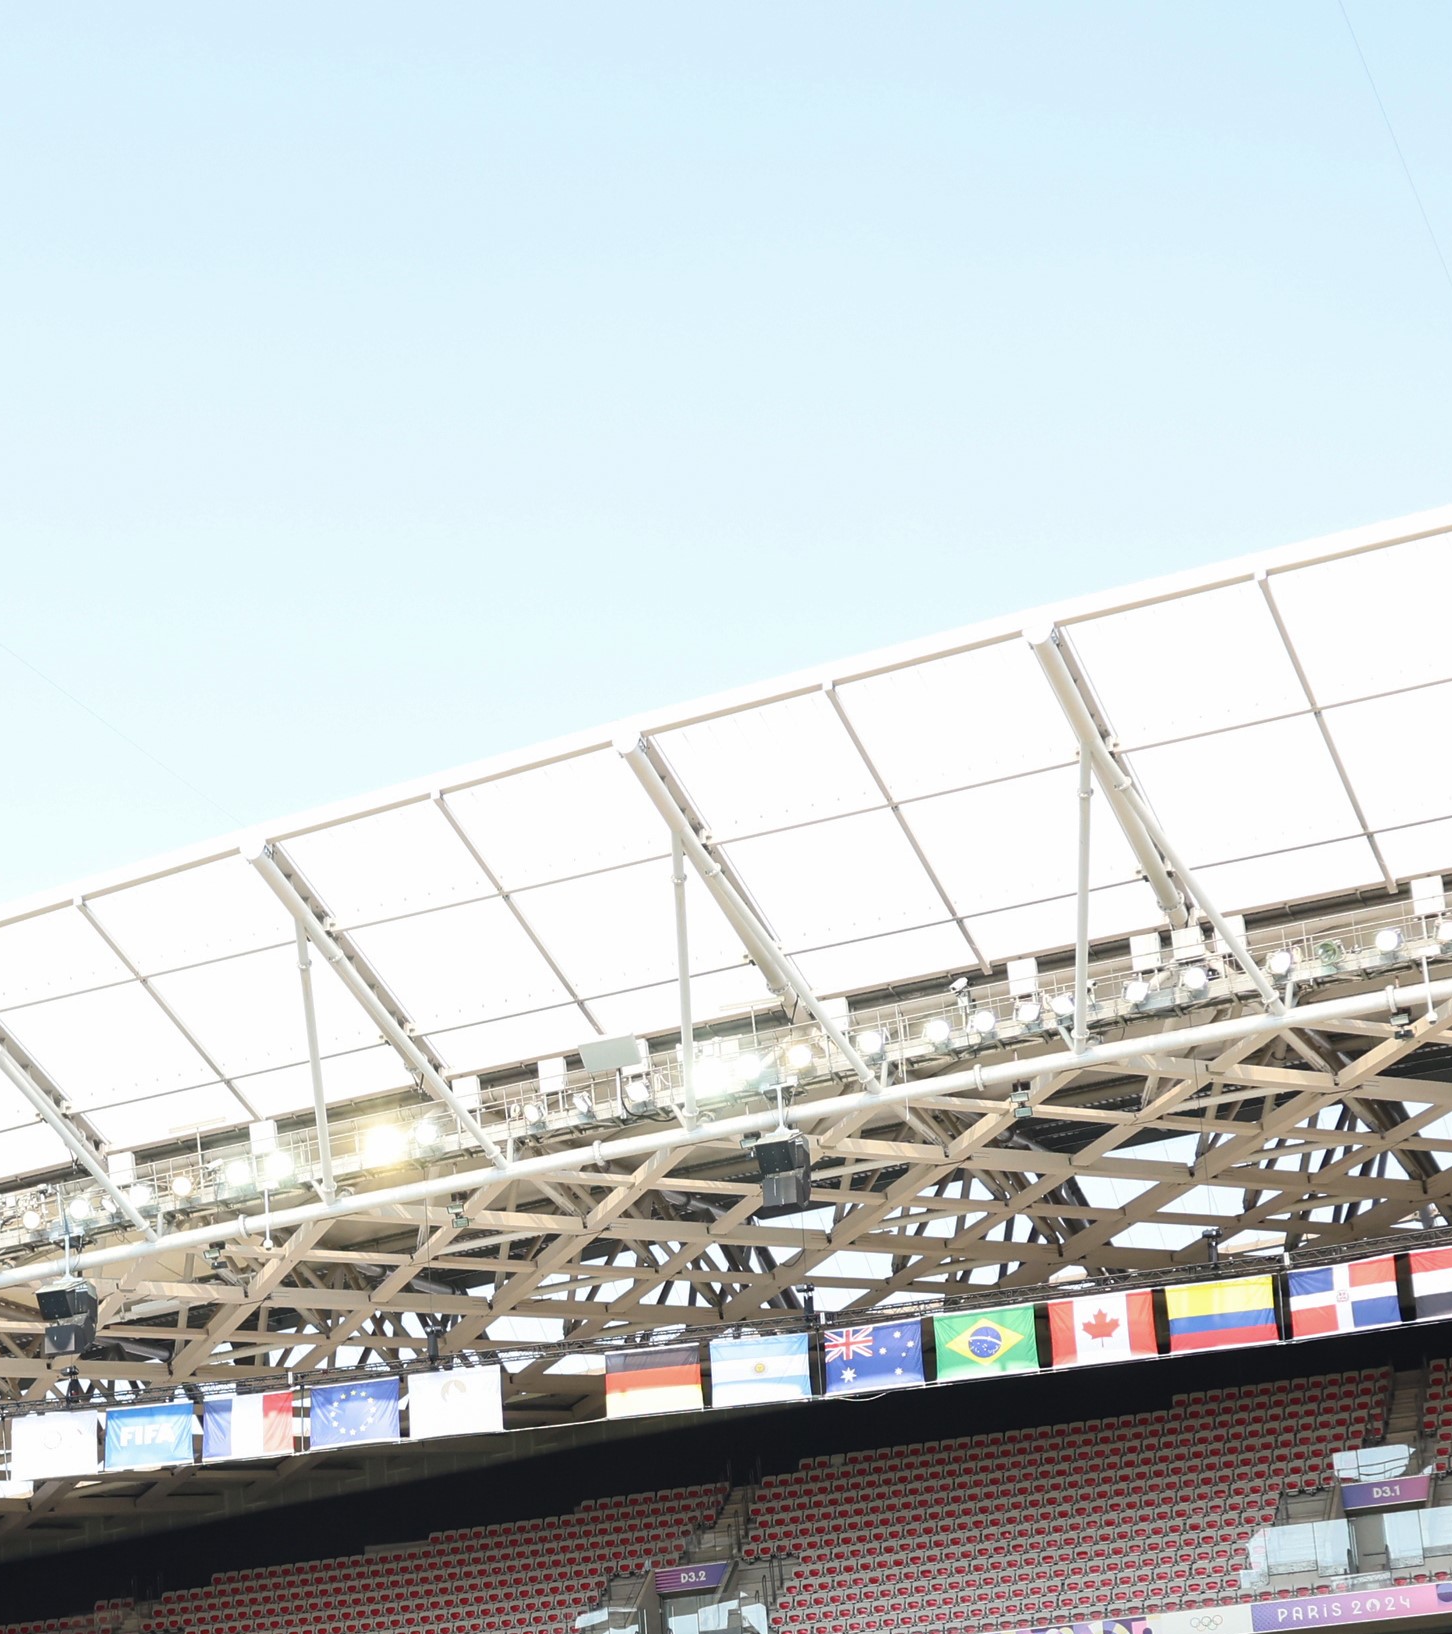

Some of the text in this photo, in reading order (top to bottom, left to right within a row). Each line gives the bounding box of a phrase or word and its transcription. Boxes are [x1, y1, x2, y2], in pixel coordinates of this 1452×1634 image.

[120, 1423, 175, 1446] FIFA
[1372, 1485, 1400, 1499] D3.1
[680, 1570, 707, 1584] D3.2
[1352, 1594, 1410, 1614] 2024
